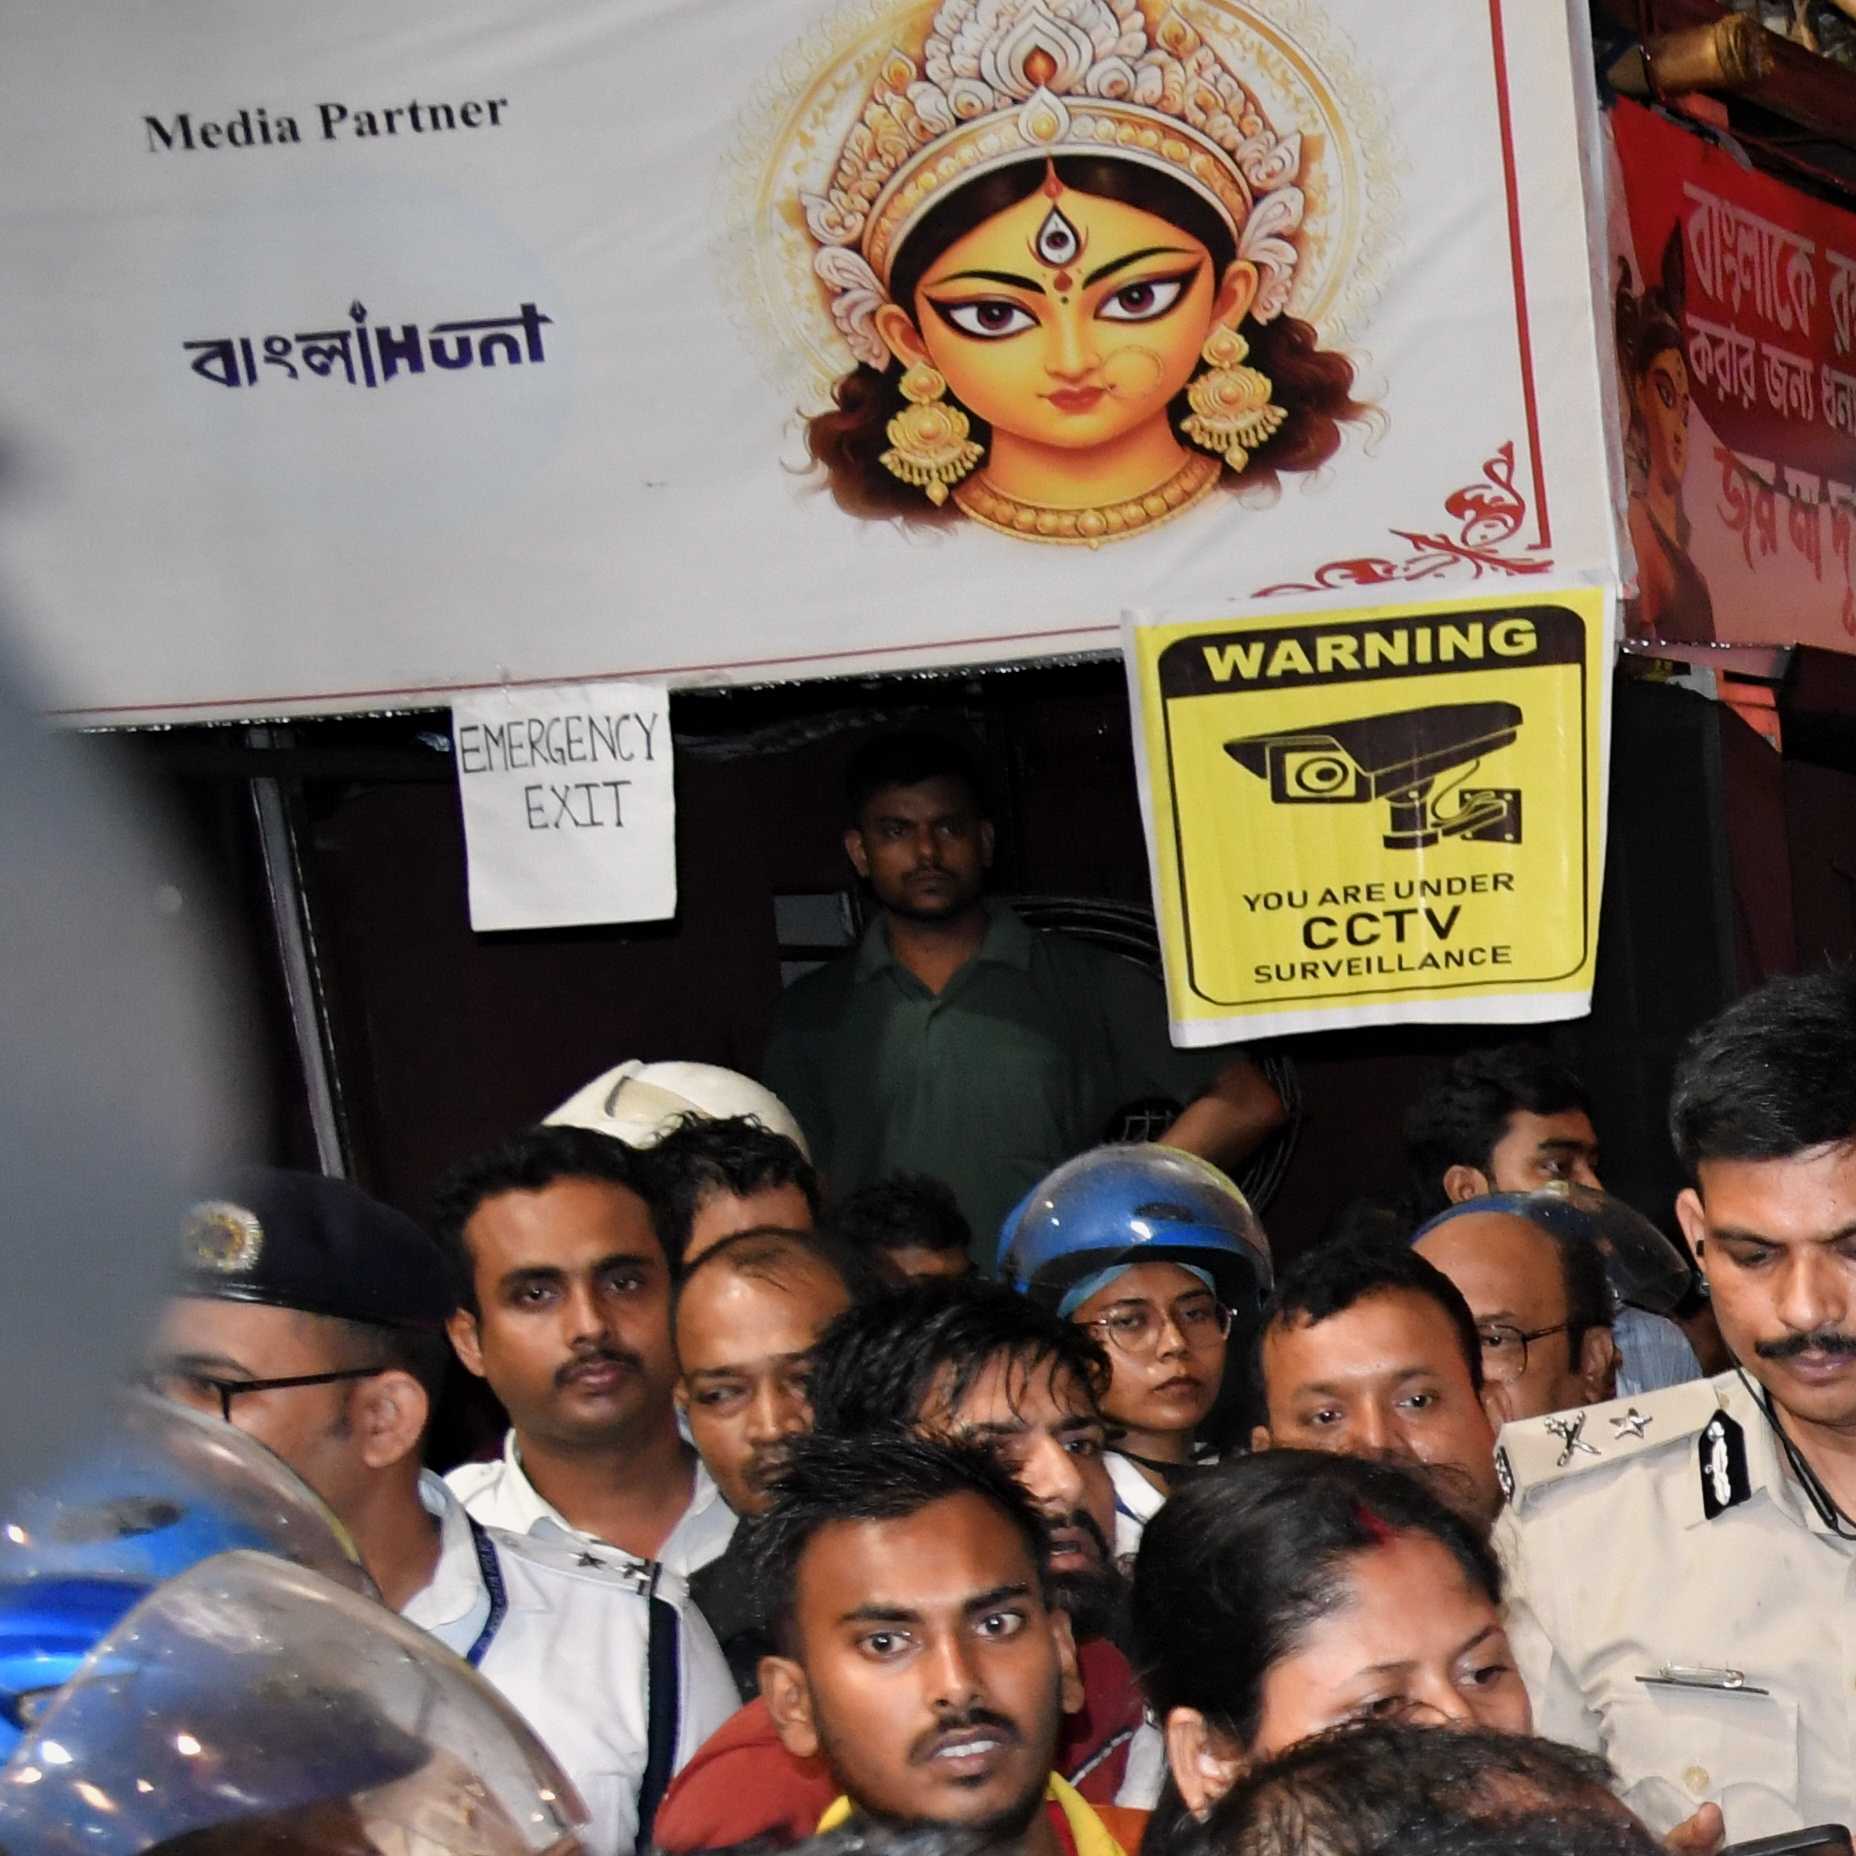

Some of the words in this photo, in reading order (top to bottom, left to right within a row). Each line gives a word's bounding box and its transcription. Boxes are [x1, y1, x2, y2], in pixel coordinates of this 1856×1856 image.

[144, 109, 301, 153] Media
[318, 96, 509, 142] Partner
[1201, 620, 1540, 685] WARNING
[459, 713, 660, 776] EMERGENCY
[525, 780, 632, 830] EXIT
[1241, 888, 1309, 912] YOU
[1316, 882, 1390, 905] ARE
[1395, 873, 1515, 902] UNDER
[1301, 905, 1464, 950] CCTV
[1252, 946, 1513, 983] SURVEILLANCE
